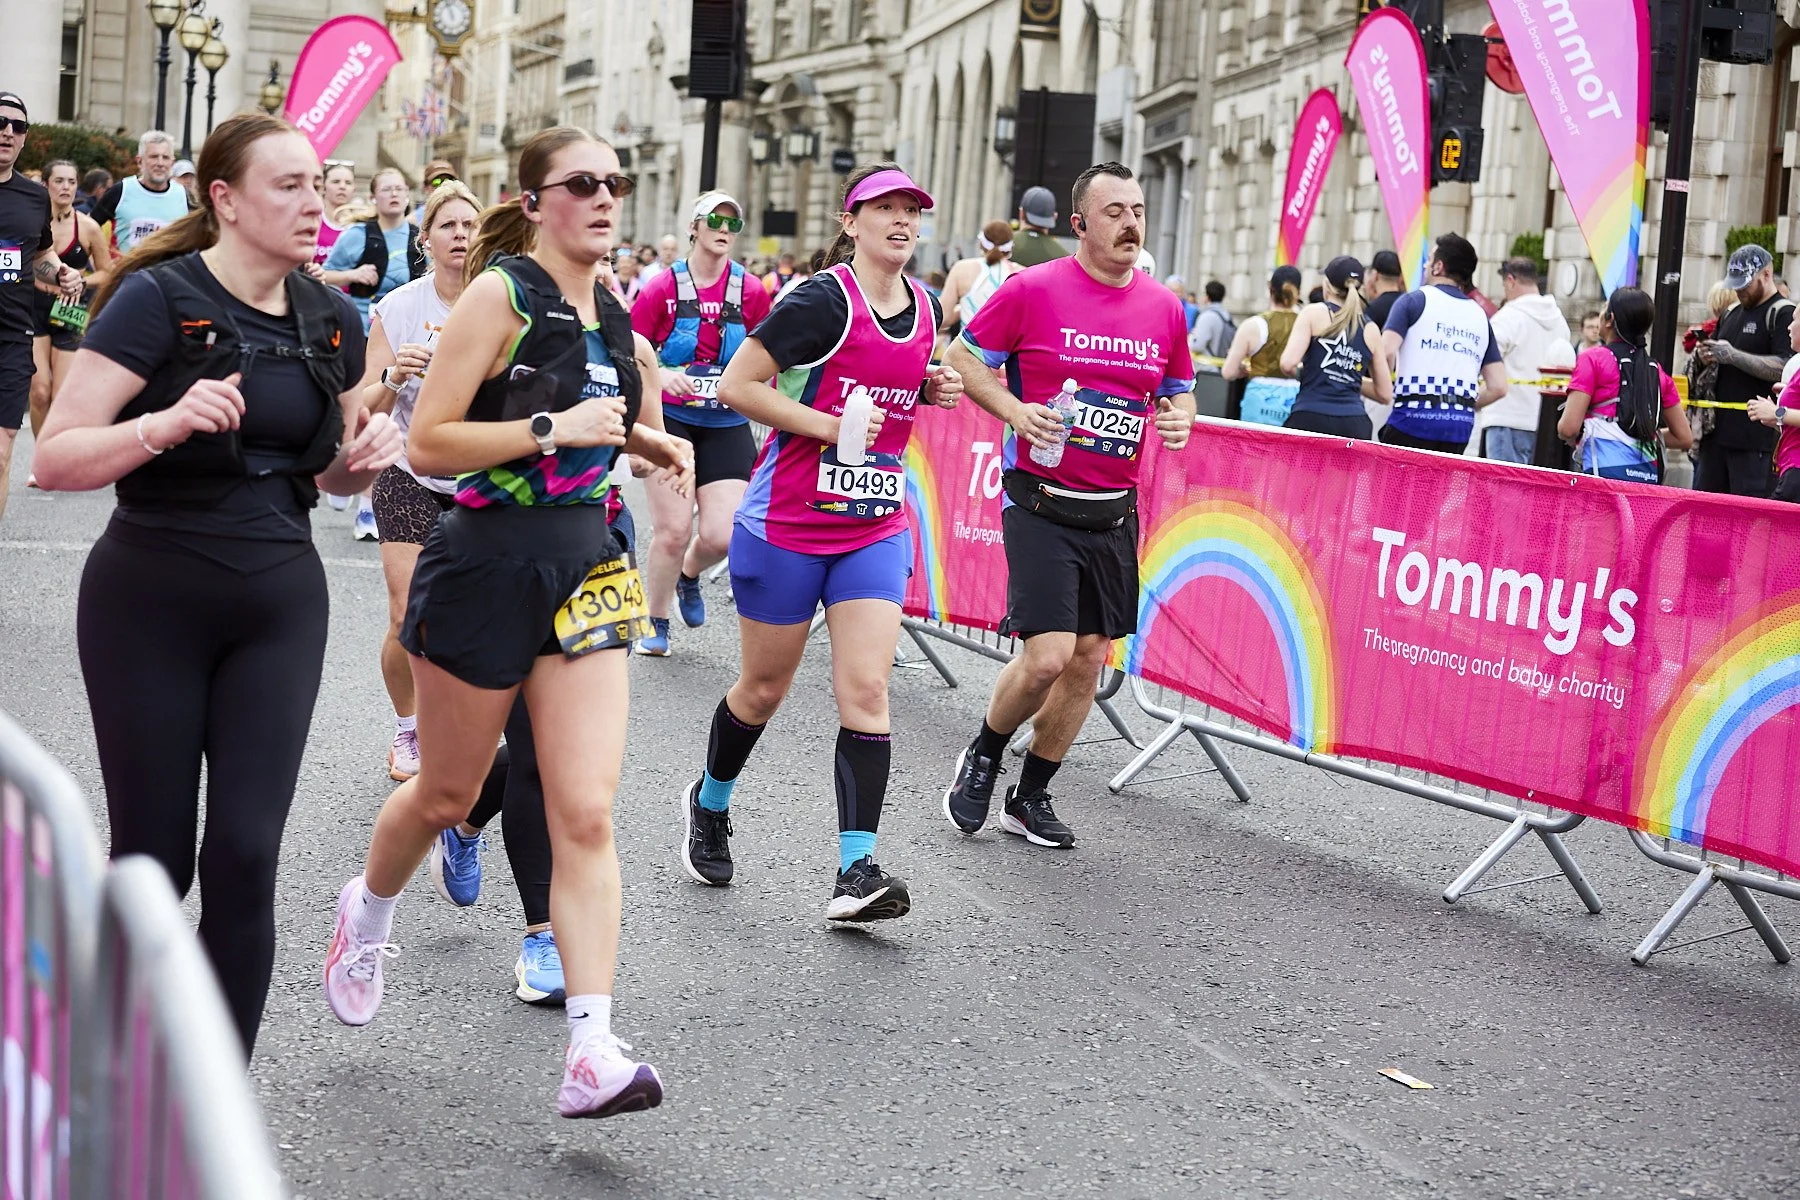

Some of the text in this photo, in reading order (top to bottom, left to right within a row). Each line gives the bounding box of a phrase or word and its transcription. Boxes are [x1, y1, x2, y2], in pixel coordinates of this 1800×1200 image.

[296, 40, 373, 133] Tommy's
[1287, 115, 1330, 218] Tommy's
[1060, 328, 1160, 361] Tommy's
[1420, 339, 1449, 352] Male
[1436, 322, 1481, 347] Fighting
[1059, 354, 1073, 363] The
[1073, 355, 1110, 367] pregnancy
[1124, 361, 1142, 371] baby
[1105, 396, 1129, 408] AIDEN
[1078, 406, 1142, 440] 10254
[826, 467, 898, 497] 10493
[955, 520, 971, 539] The
[563, 578, 643, 625] 13043
[1371, 526, 1639, 656] Tommy's
[1363, 628, 1626, 709] The pregnancy and baby charity
